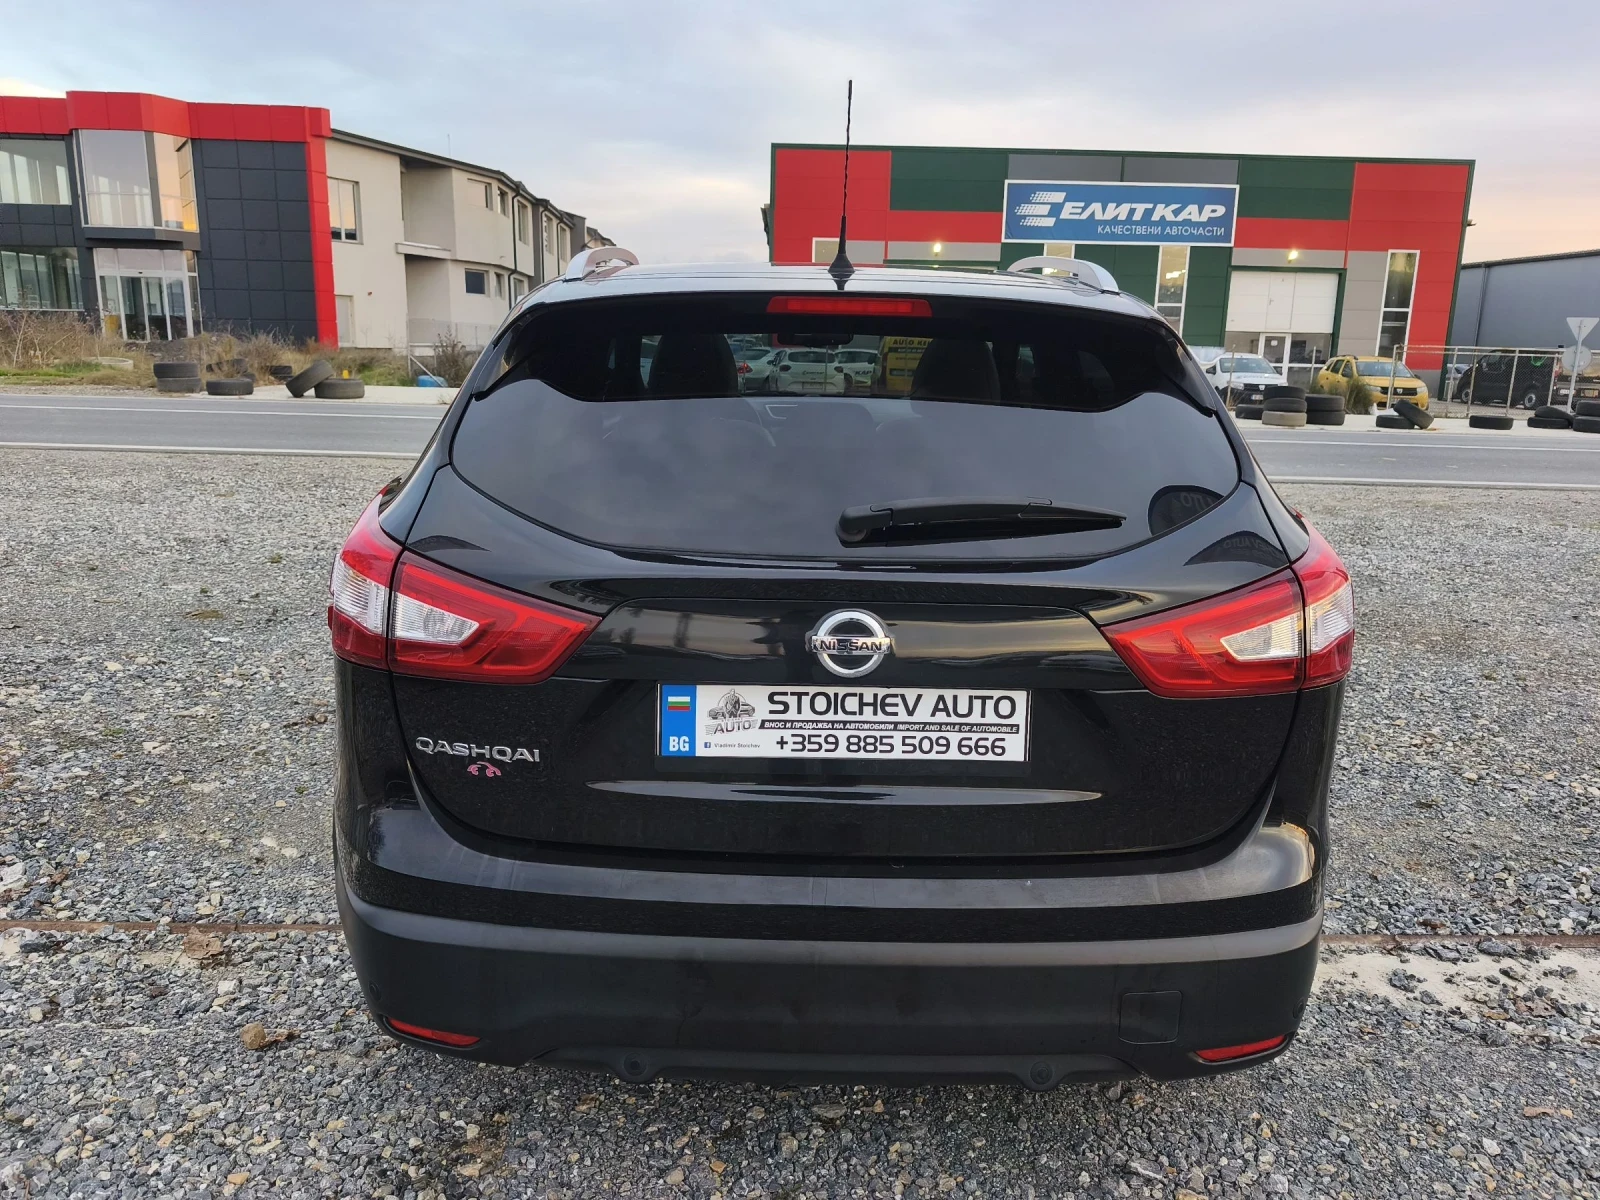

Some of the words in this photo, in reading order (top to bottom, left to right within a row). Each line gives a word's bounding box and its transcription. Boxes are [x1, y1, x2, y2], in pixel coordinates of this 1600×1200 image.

[1097, 224, 1161, 235] КАЧЕСТВЕНИ
[1164, 226, 1224, 236] АВТОЧАСТИ
[820, 640, 882, 651] NISSAN
[767, 691, 923, 717] STOICHEV
[930, 694, 1016, 719] AUTO
[713, 720, 752, 735] AUTO
[764, 721, 785, 729] ВНОС
[792, 721, 832, 730] ПРОДАЖБА
[834, 722, 844, 730] НА
[845, 722, 894, 731] АВТОМОБИЛИ
[897, 723, 923, 731] IMPORT
[941, 724, 960, 732] SALE
[971, 725, 1018, 733] AUTOMOBILE
[415, 736, 540, 763] QASHQAI
[669, 735, 690, 752] BG
[776, 733, 839, 753] +359
[846, 734, 894, 754] 885
[901, 735, 951, 755] 509
[957, 736, 1006, 757] 666
